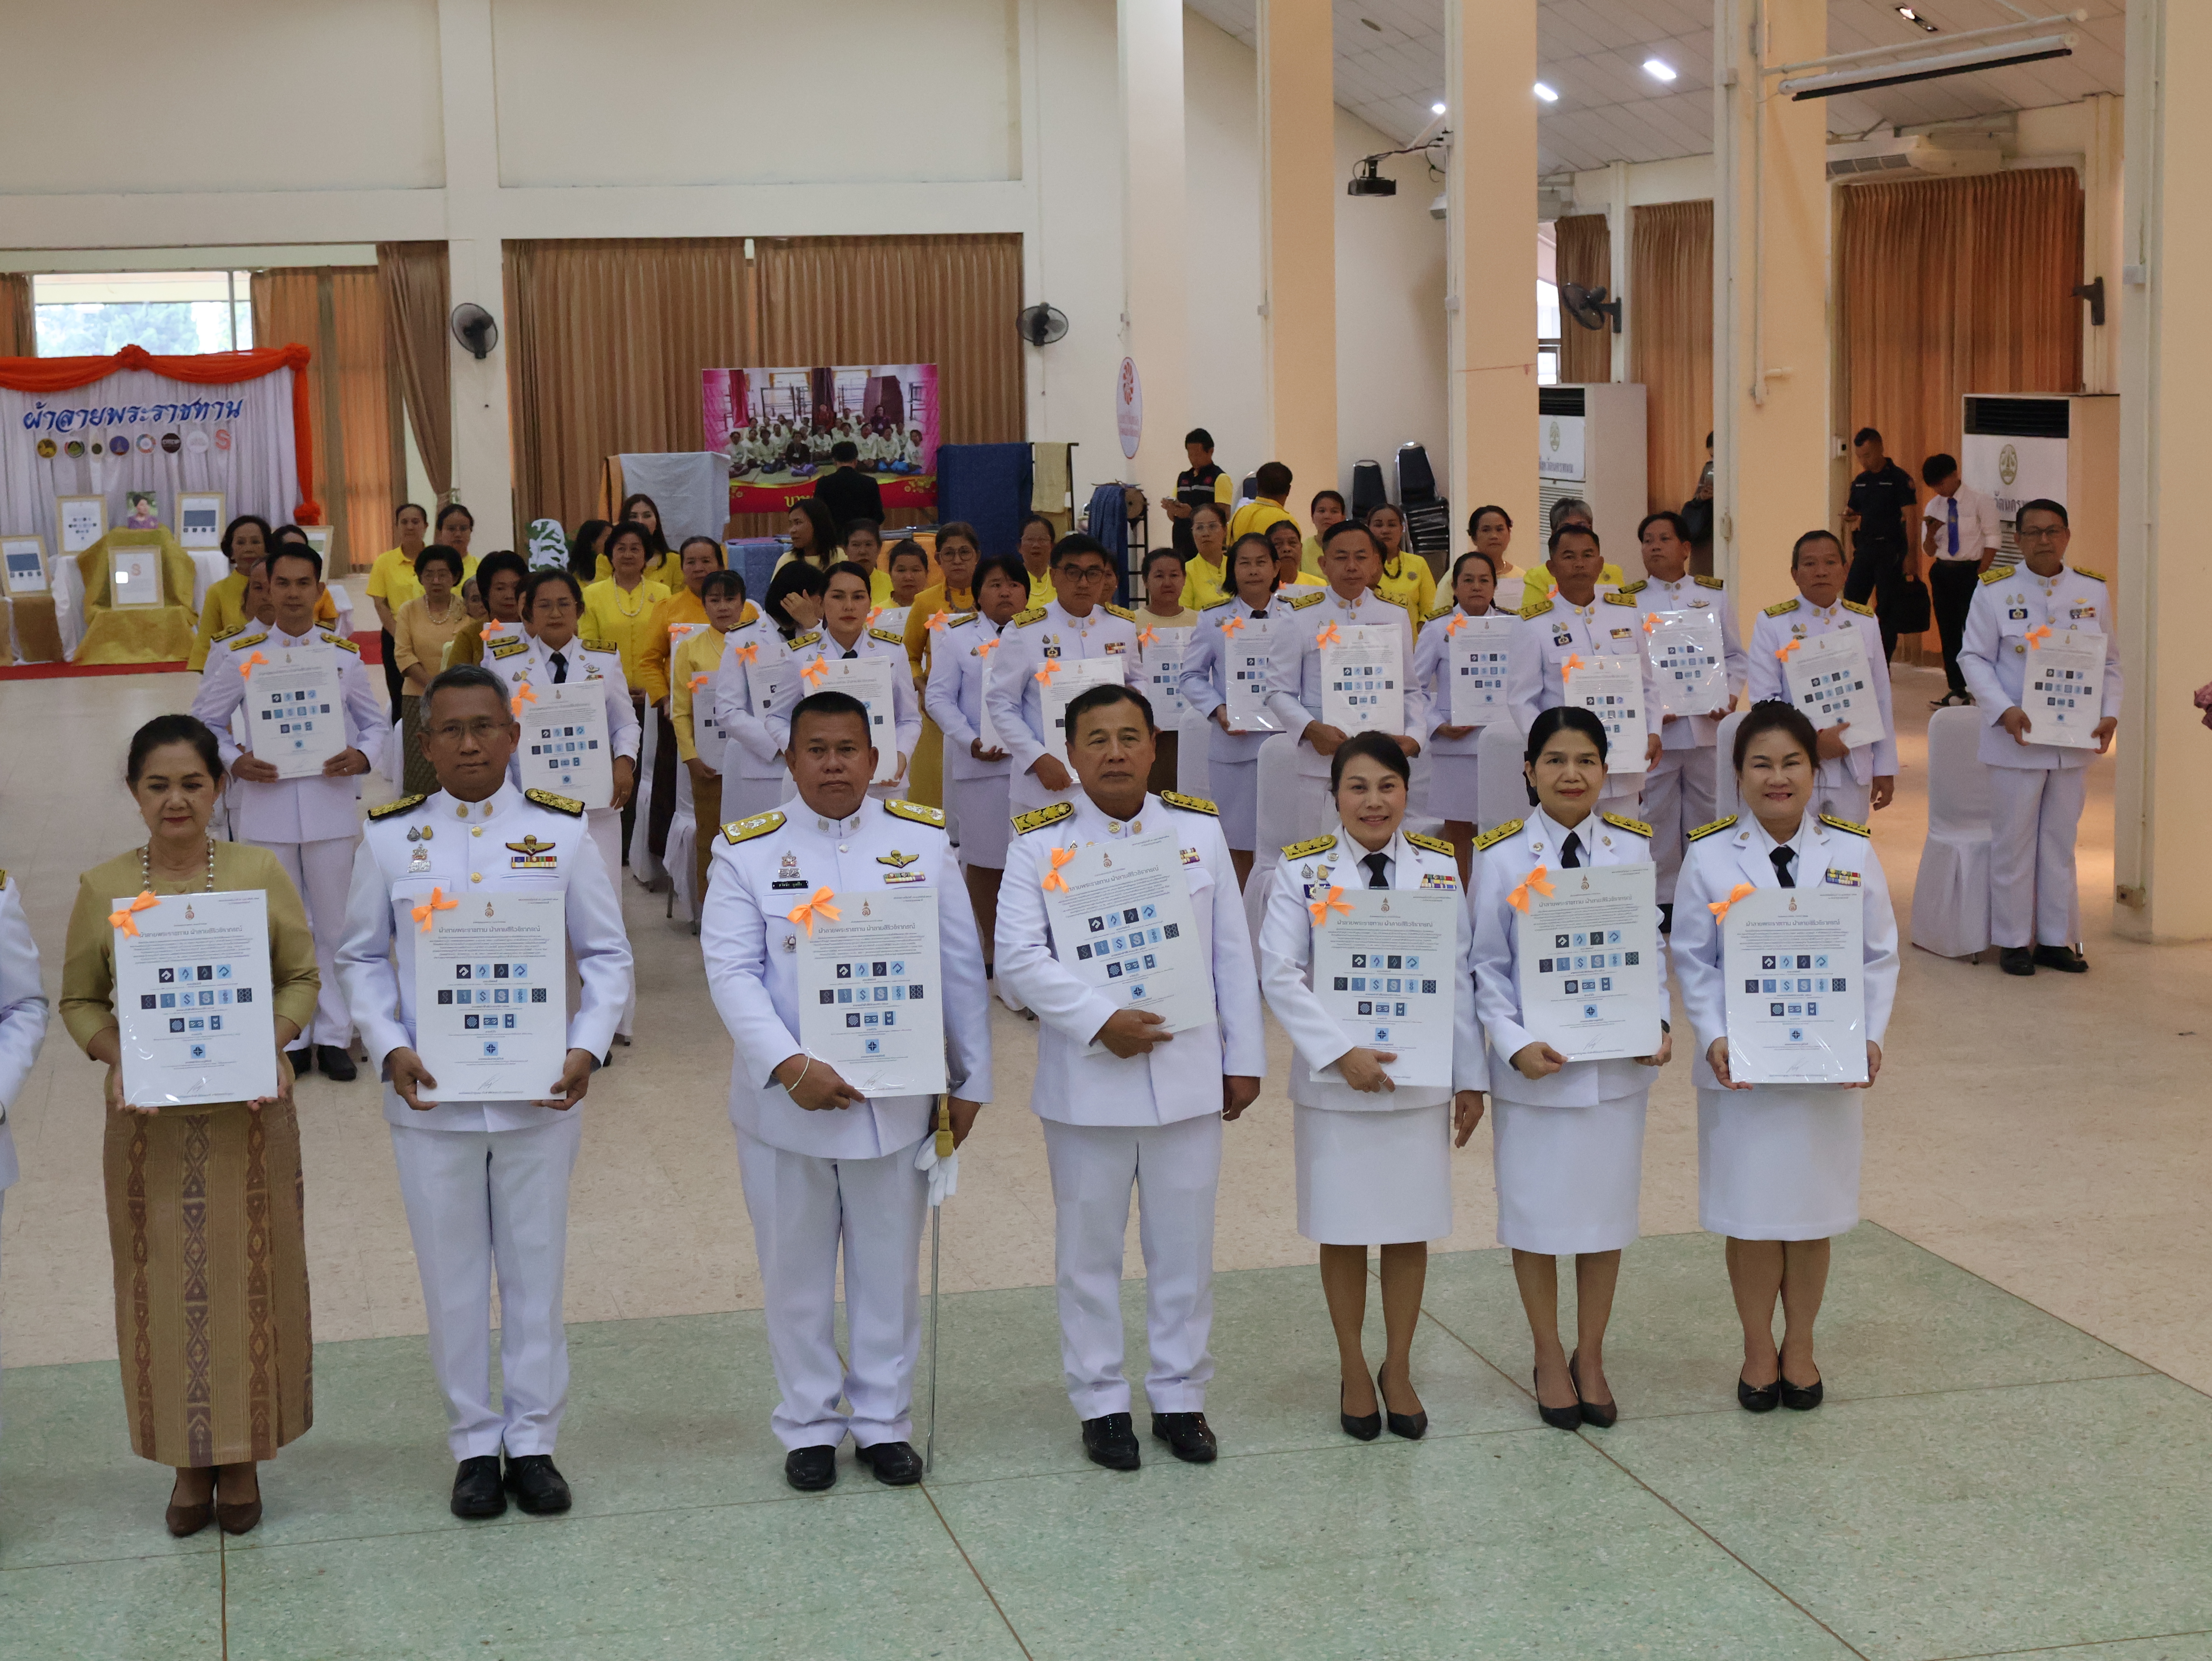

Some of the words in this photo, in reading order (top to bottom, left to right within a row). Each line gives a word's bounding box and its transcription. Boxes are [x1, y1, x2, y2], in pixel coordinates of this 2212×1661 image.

[23, 397, 244, 433] ผ้าลายพระราชทาน
